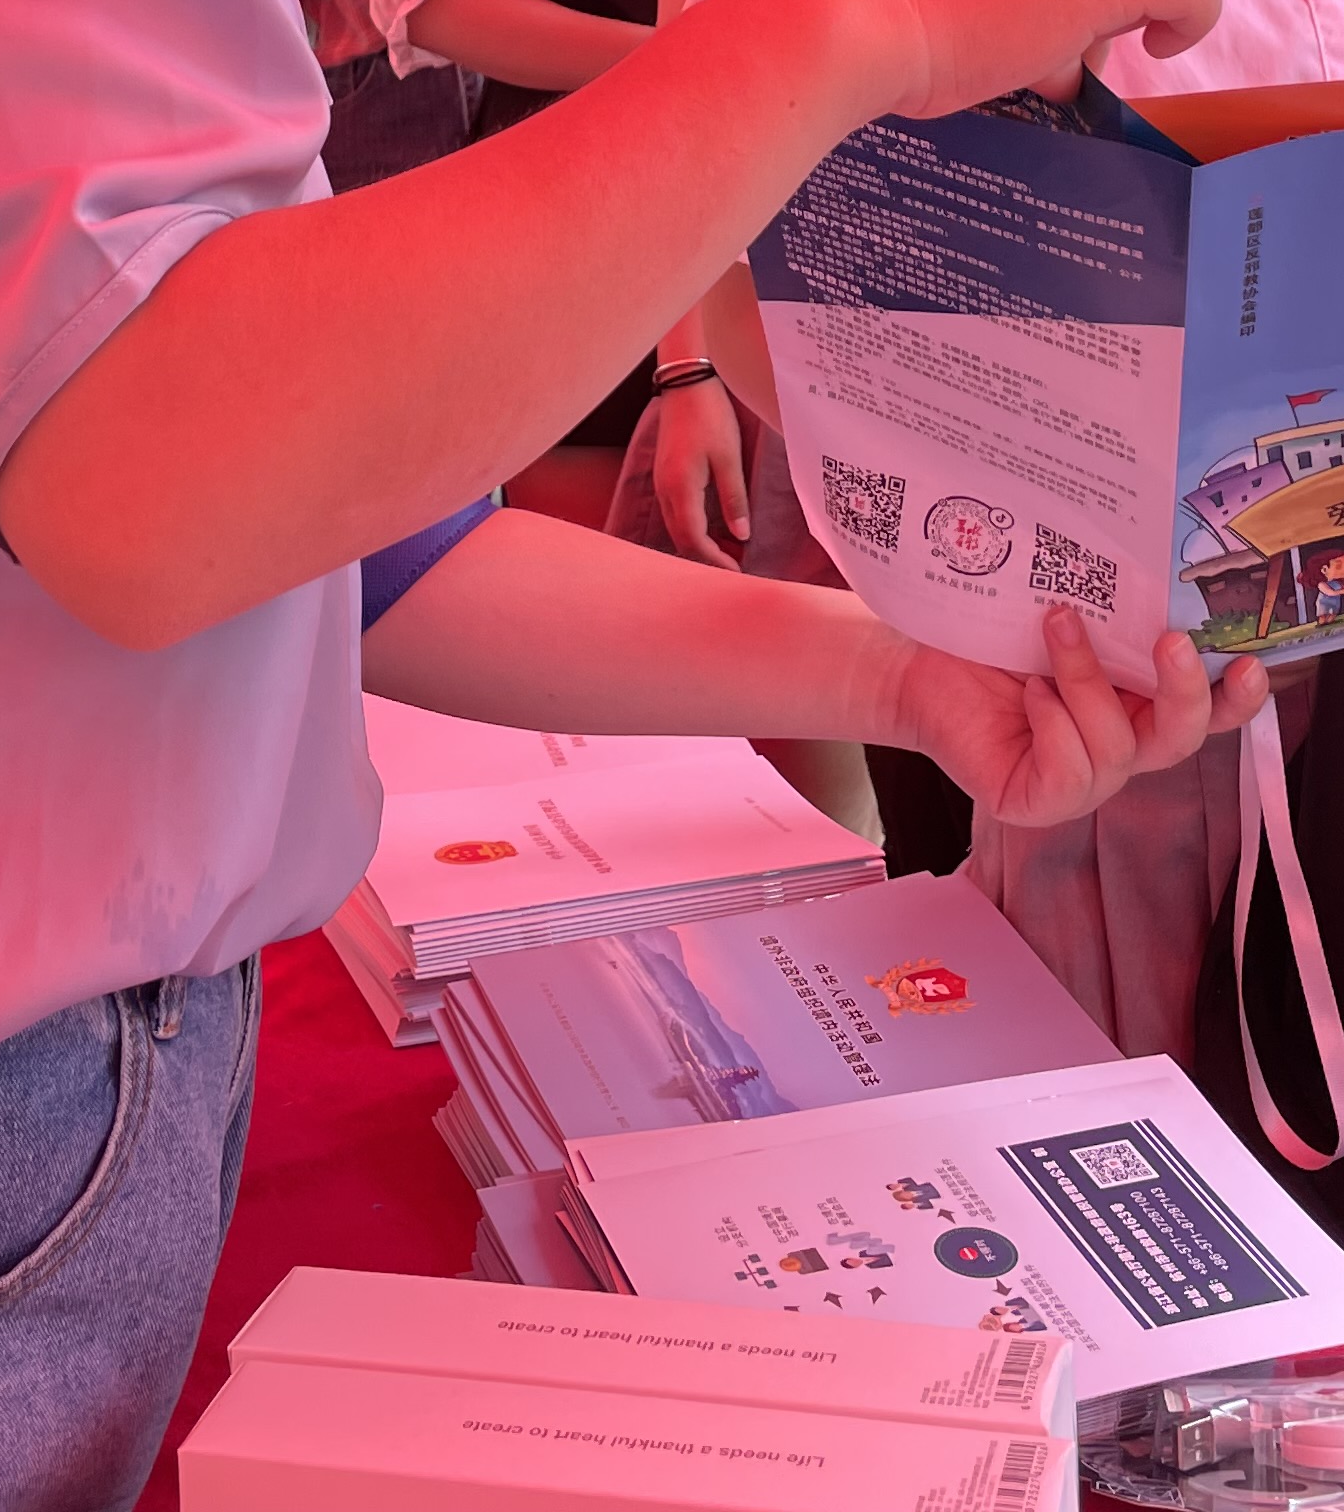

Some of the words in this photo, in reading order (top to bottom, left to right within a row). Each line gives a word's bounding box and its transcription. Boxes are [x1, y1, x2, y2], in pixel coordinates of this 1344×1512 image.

[812, 962, 883, 1045] 中华人民共和国
[759, 935, 882, 1088] 境外非政府组织境内活动管理法
[496, 1320, 555, 1333] create
[560, 1326, 579, 1338] to
[582, 1327, 633, 1343] heart
[637, 1334, 715, 1352] thankful
[720, 1341, 733, 1351] a
[738, 1343, 796, 1358] needs
[802, 1350, 838, 1365] Life
[462, 1419, 524, 1433] create
[528, 1426, 549, 1439] to
[553, 1428, 607, 1446] heart
[610, 1436, 695, 1455] thankful
[699, 1444, 713, 1454] a
[718, 1446, 781, 1462] needs
[786, 1452, 826, 1468] Life
